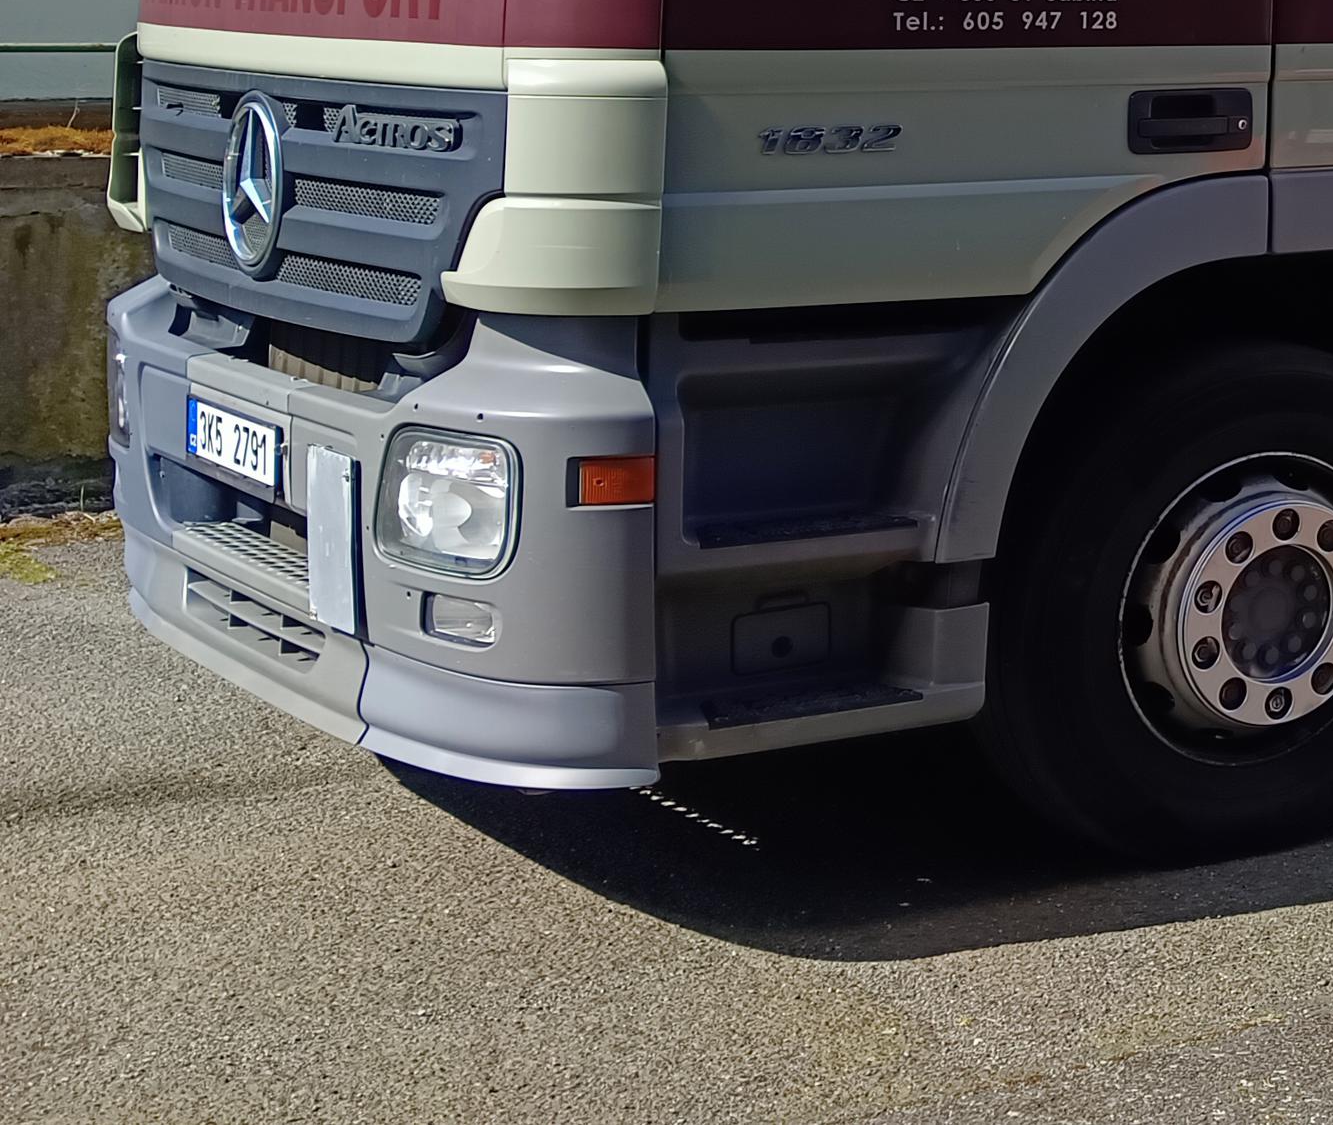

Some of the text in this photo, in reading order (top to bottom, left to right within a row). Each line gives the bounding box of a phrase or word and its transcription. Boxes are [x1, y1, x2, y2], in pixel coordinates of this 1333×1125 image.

[893, 11, 1118, 31] Tel.: 605 947 128
[758, 124, 903, 155] 1832
[199, 410, 267, 476] 3K5 2791
